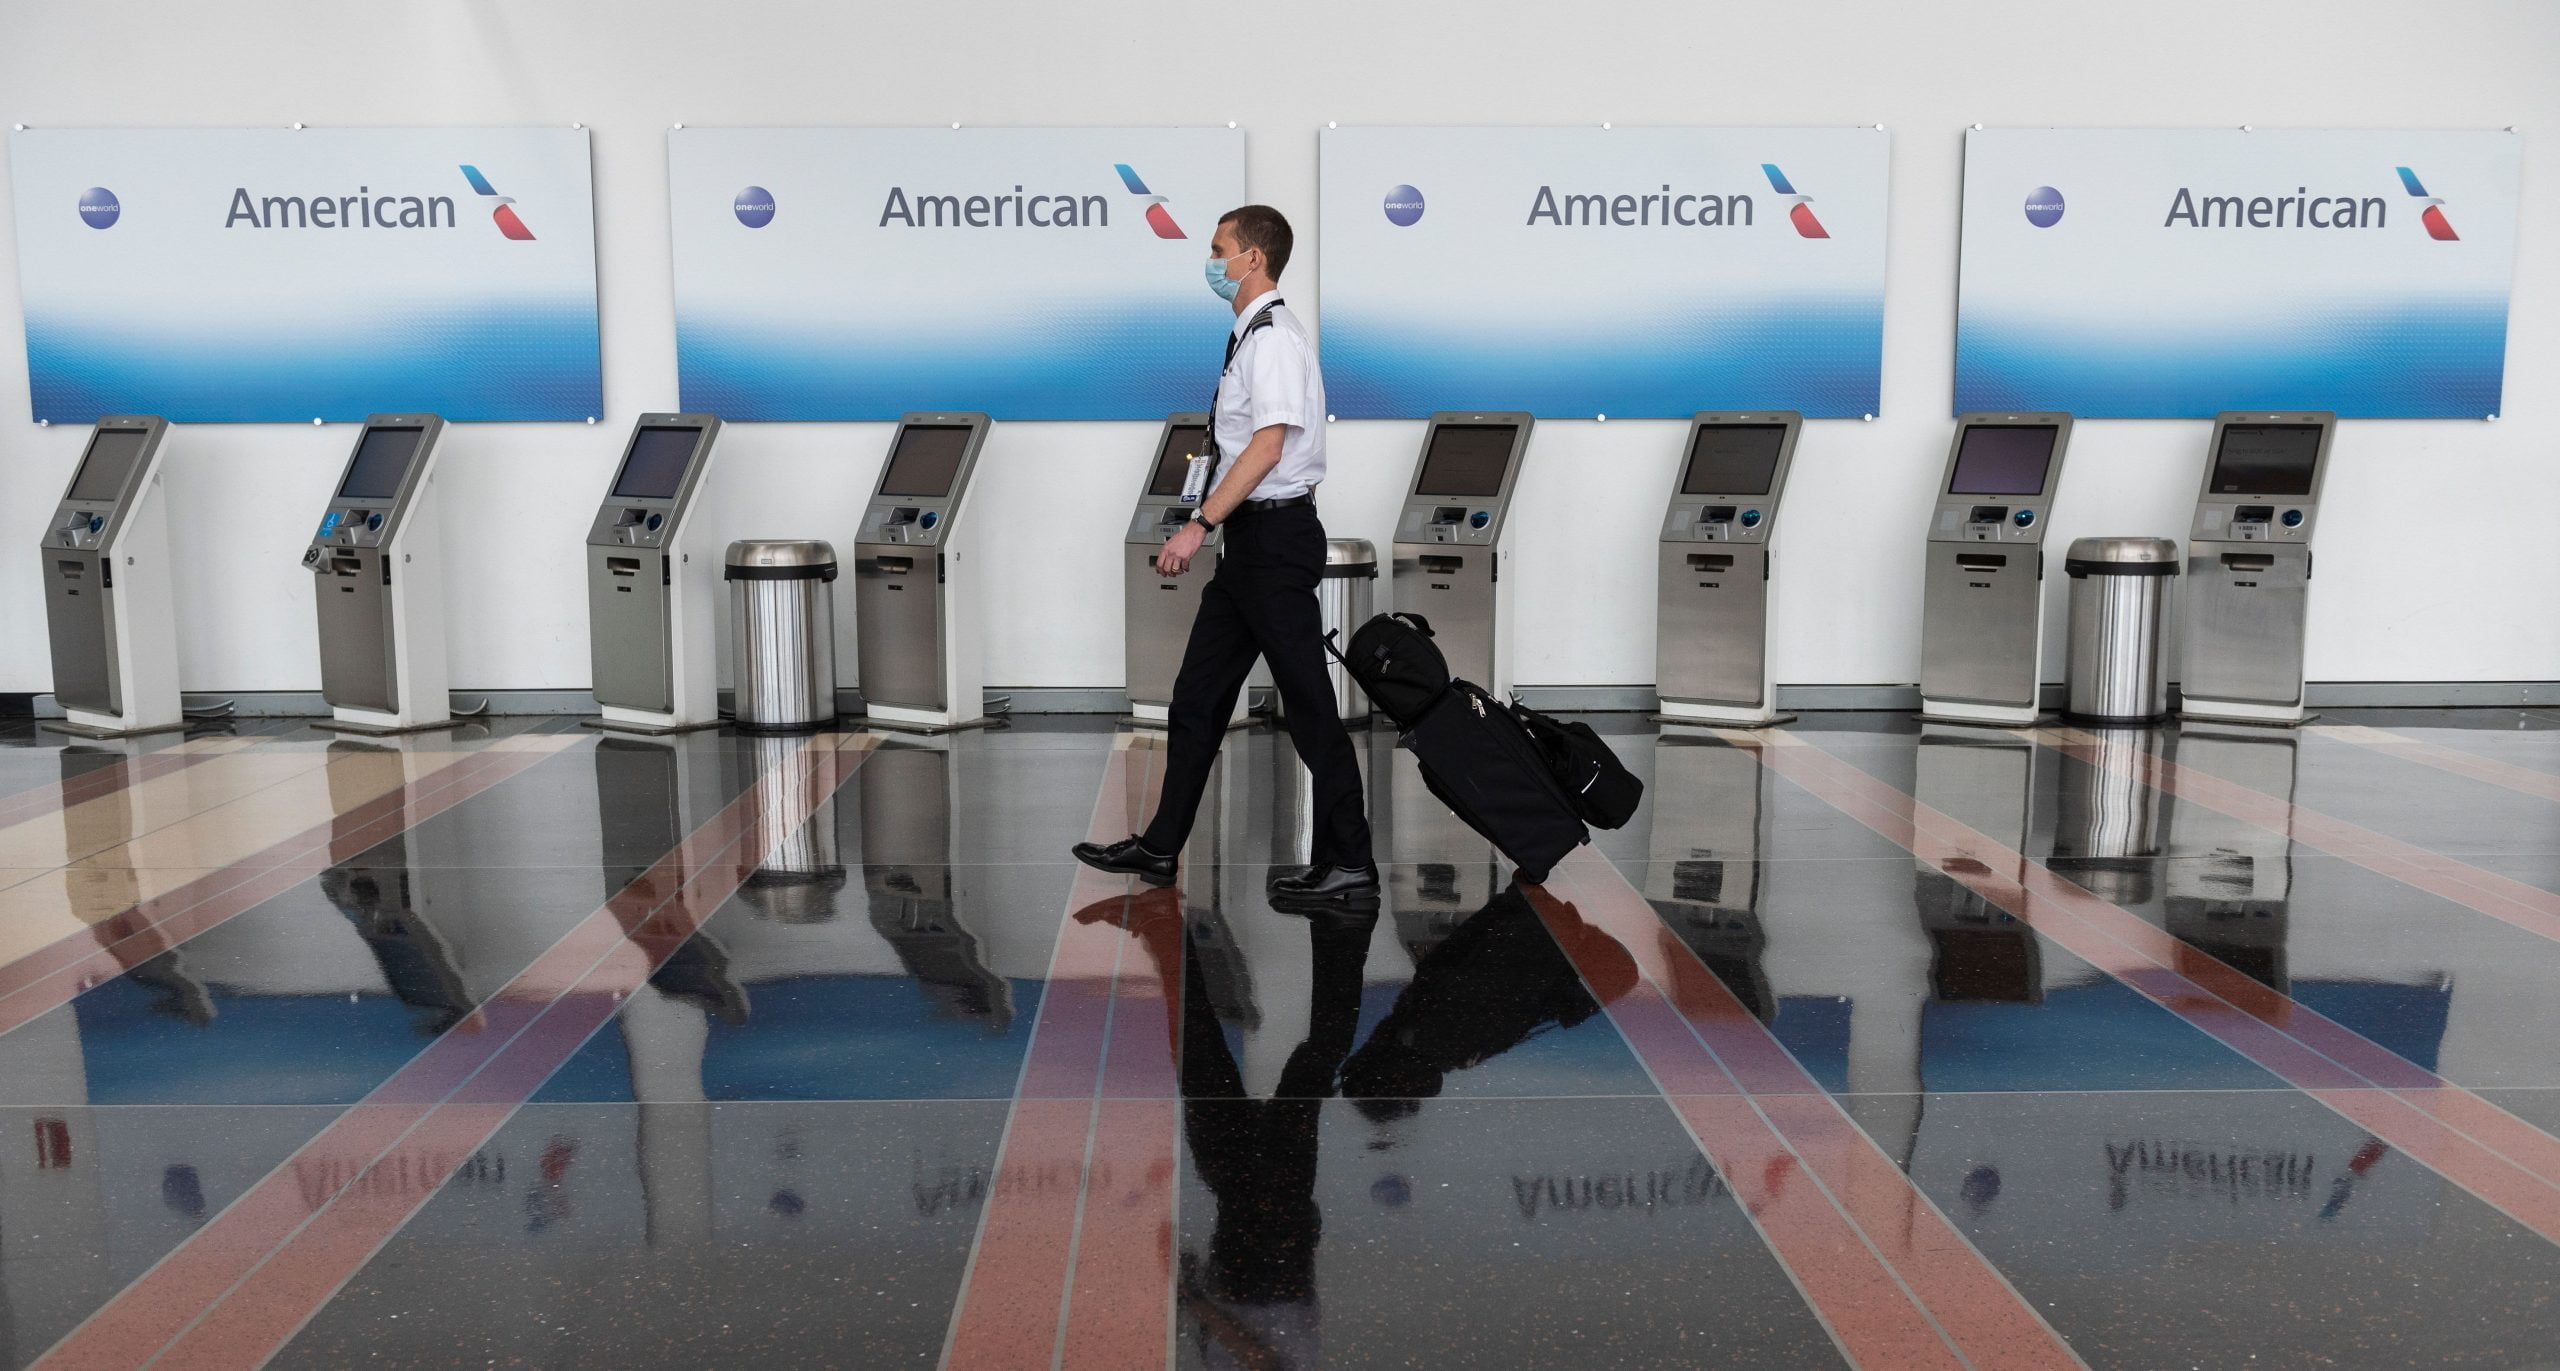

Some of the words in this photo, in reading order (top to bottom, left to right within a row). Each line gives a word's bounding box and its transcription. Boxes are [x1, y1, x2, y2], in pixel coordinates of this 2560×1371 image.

[80, 204, 118, 212] oneworld
[225, 186, 456, 229] American
[735, 203, 774, 211] oneworld
[880, 185, 1108, 228] American
[1526, 184, 1753, 227] American
[2026, 203, 2063, 211] oneworld
[2164, 186, 2387, 229] American
